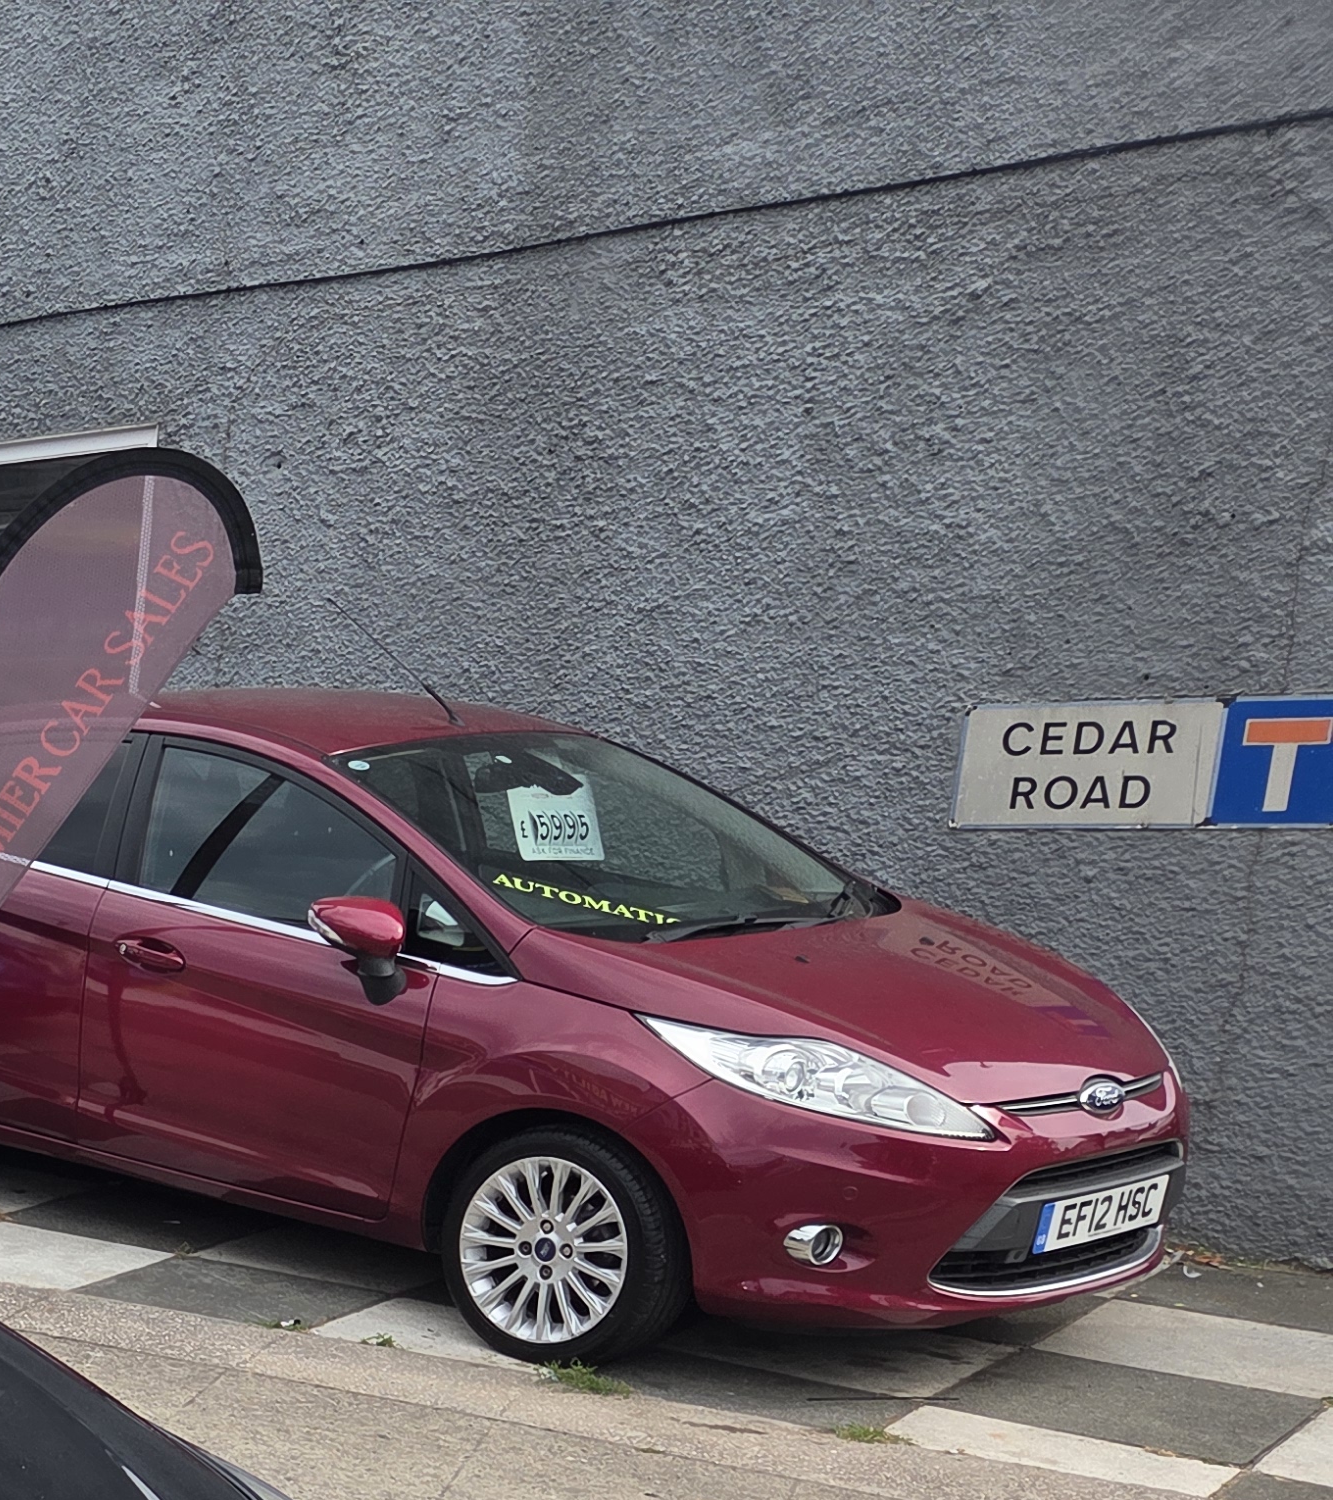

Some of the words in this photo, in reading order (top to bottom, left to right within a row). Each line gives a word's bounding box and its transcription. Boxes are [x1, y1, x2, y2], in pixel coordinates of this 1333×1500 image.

[40, 667, 124, 758] CAR
[103, 530, 216, 665] SALES
[1001, 719, 1177, 756] CEDAR
[1008, 775, 1152, 810] ROAD
[1056, 1195, 1114, 1241] EF12
[1113, 1183, 1159, 1227] HSC
